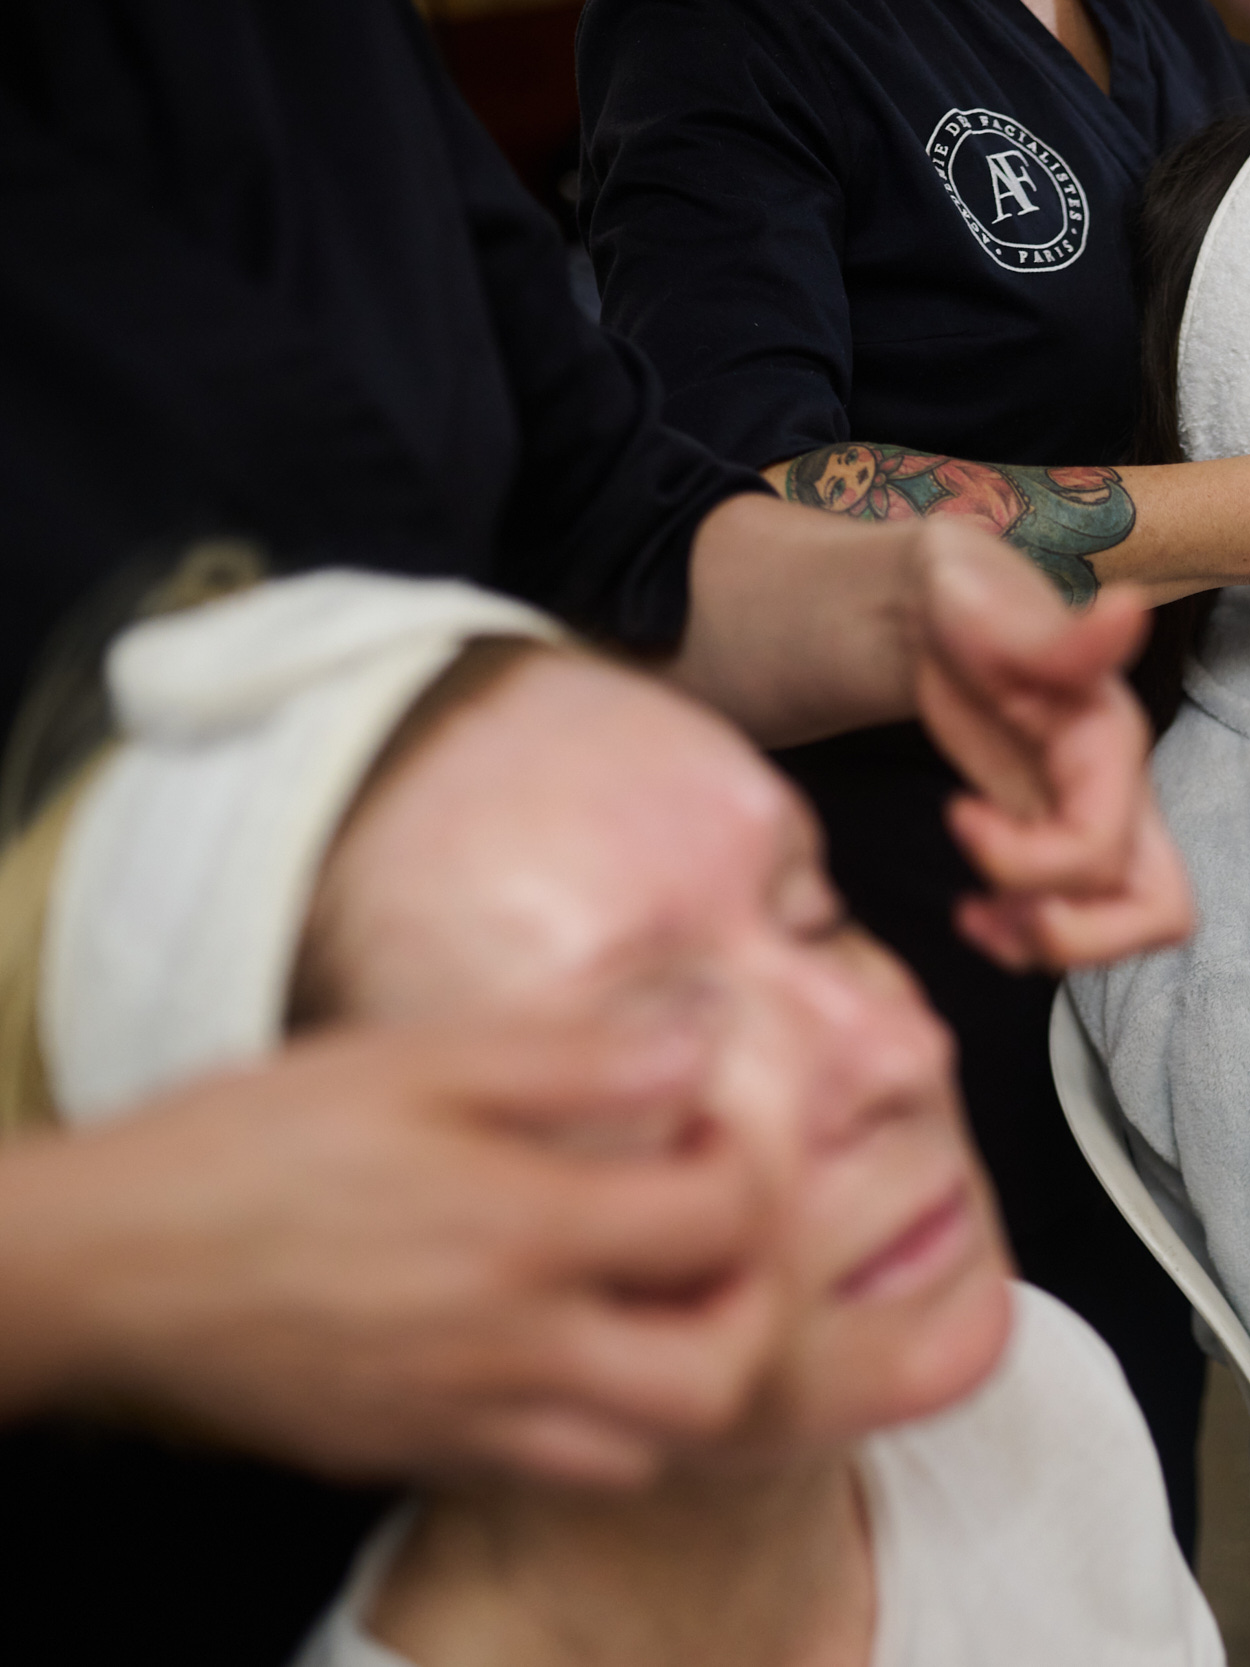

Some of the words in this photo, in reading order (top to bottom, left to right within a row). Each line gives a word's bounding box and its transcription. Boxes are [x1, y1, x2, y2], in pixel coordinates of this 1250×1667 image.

[978, 115, 1083, 222] FACIALISTES
[985, 149, 1040, 225] AF
[1018, 239, 1075, 264] PARIS
